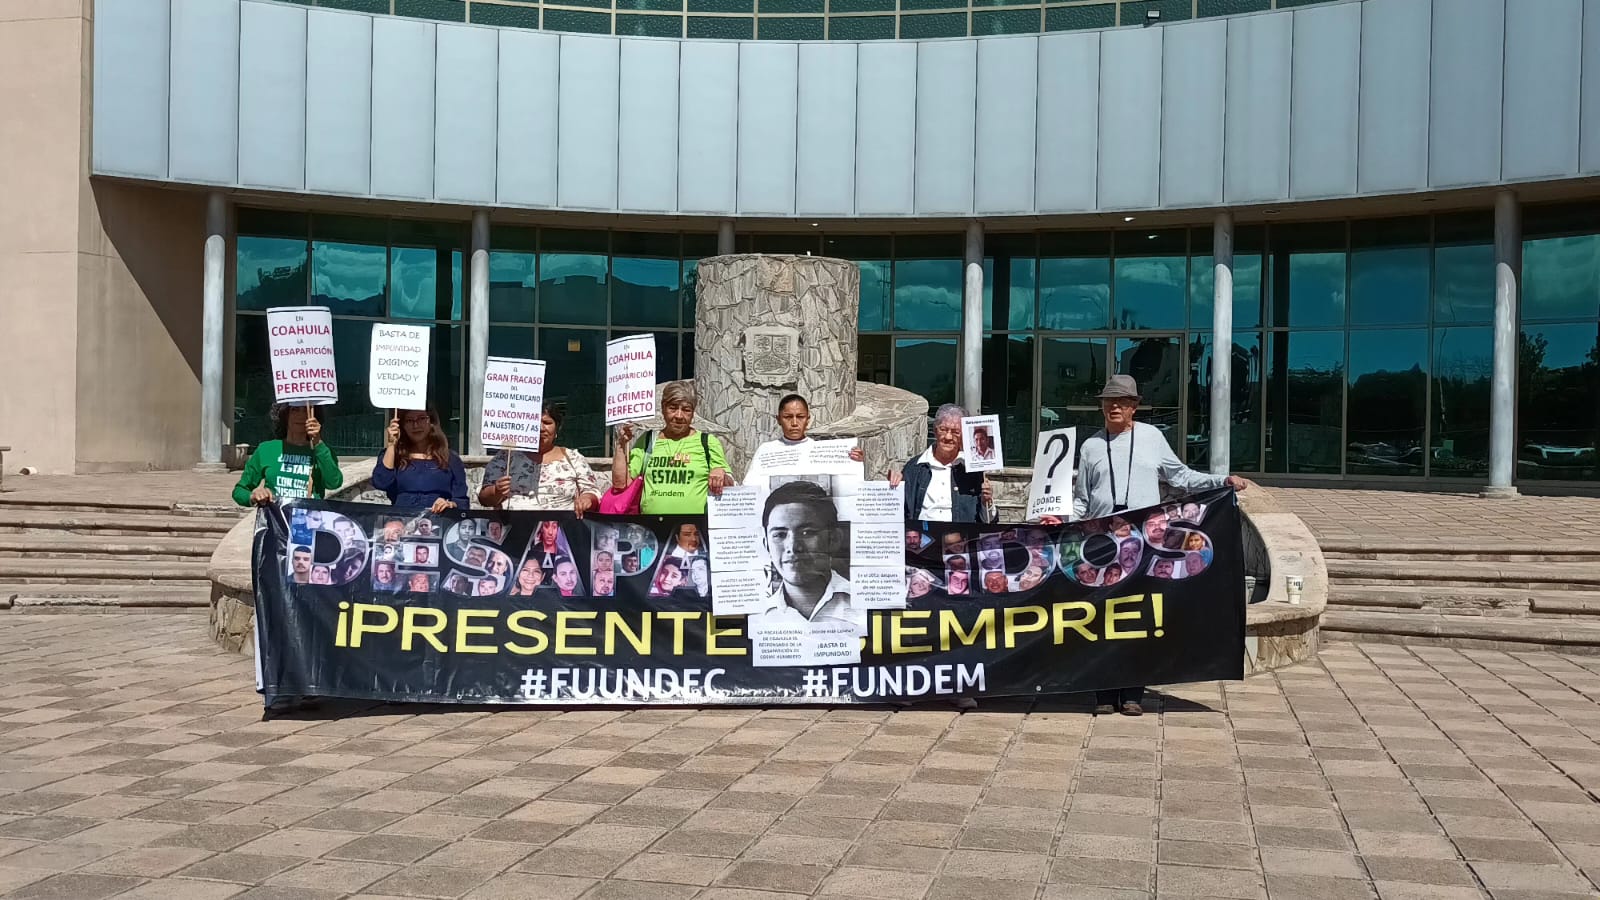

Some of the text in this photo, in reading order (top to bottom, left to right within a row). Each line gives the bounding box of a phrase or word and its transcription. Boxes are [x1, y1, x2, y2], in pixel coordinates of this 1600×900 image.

[271, 324, 330, 336] COAHUILA
[379, 329, 407, 338] BASTA
[273, 346, 332, 357] DESAPARICIÓN
[378, 358, 420, 368] EXIGIMOS
[608, 350, 653, 366] COAHUILA
[275, 368, 334, 380] EL CRIMEN
[376, 372, 419, 382] VERDAD Y
[486, 373, 543, 385] GRAN FRACASO
[608, 370, 654, 384] DESAPARICIÓN
[277, 382, 335, 394] PERFECTO
[377, 387, 416, 396] JUSTICIA
[485, 392, 541, 402] ESTADO MEXICANO
[608, 390, 653, 405] EL CRIMEN
[484, 409, 540, 421] NO ENCONTRAR
[607, 402, 653, 418] PERFECTO
[483, 420, 489, 428] A
[490, 421, 524, 431] NUESTROS
[531, 424, 539, 433] AS
[482, 432, 538, 444] DESAPARECIDOS
[1043, 433, 1069, 494] ?
[652, 470, 695, 485] ESTAN?
[286, 503, 1213, 597] DESAPAIDOS
[861, 592, 1165, 657] IEMPRE!
[520, 662, 987, 701] #FUUNDEC #FUNDEM
